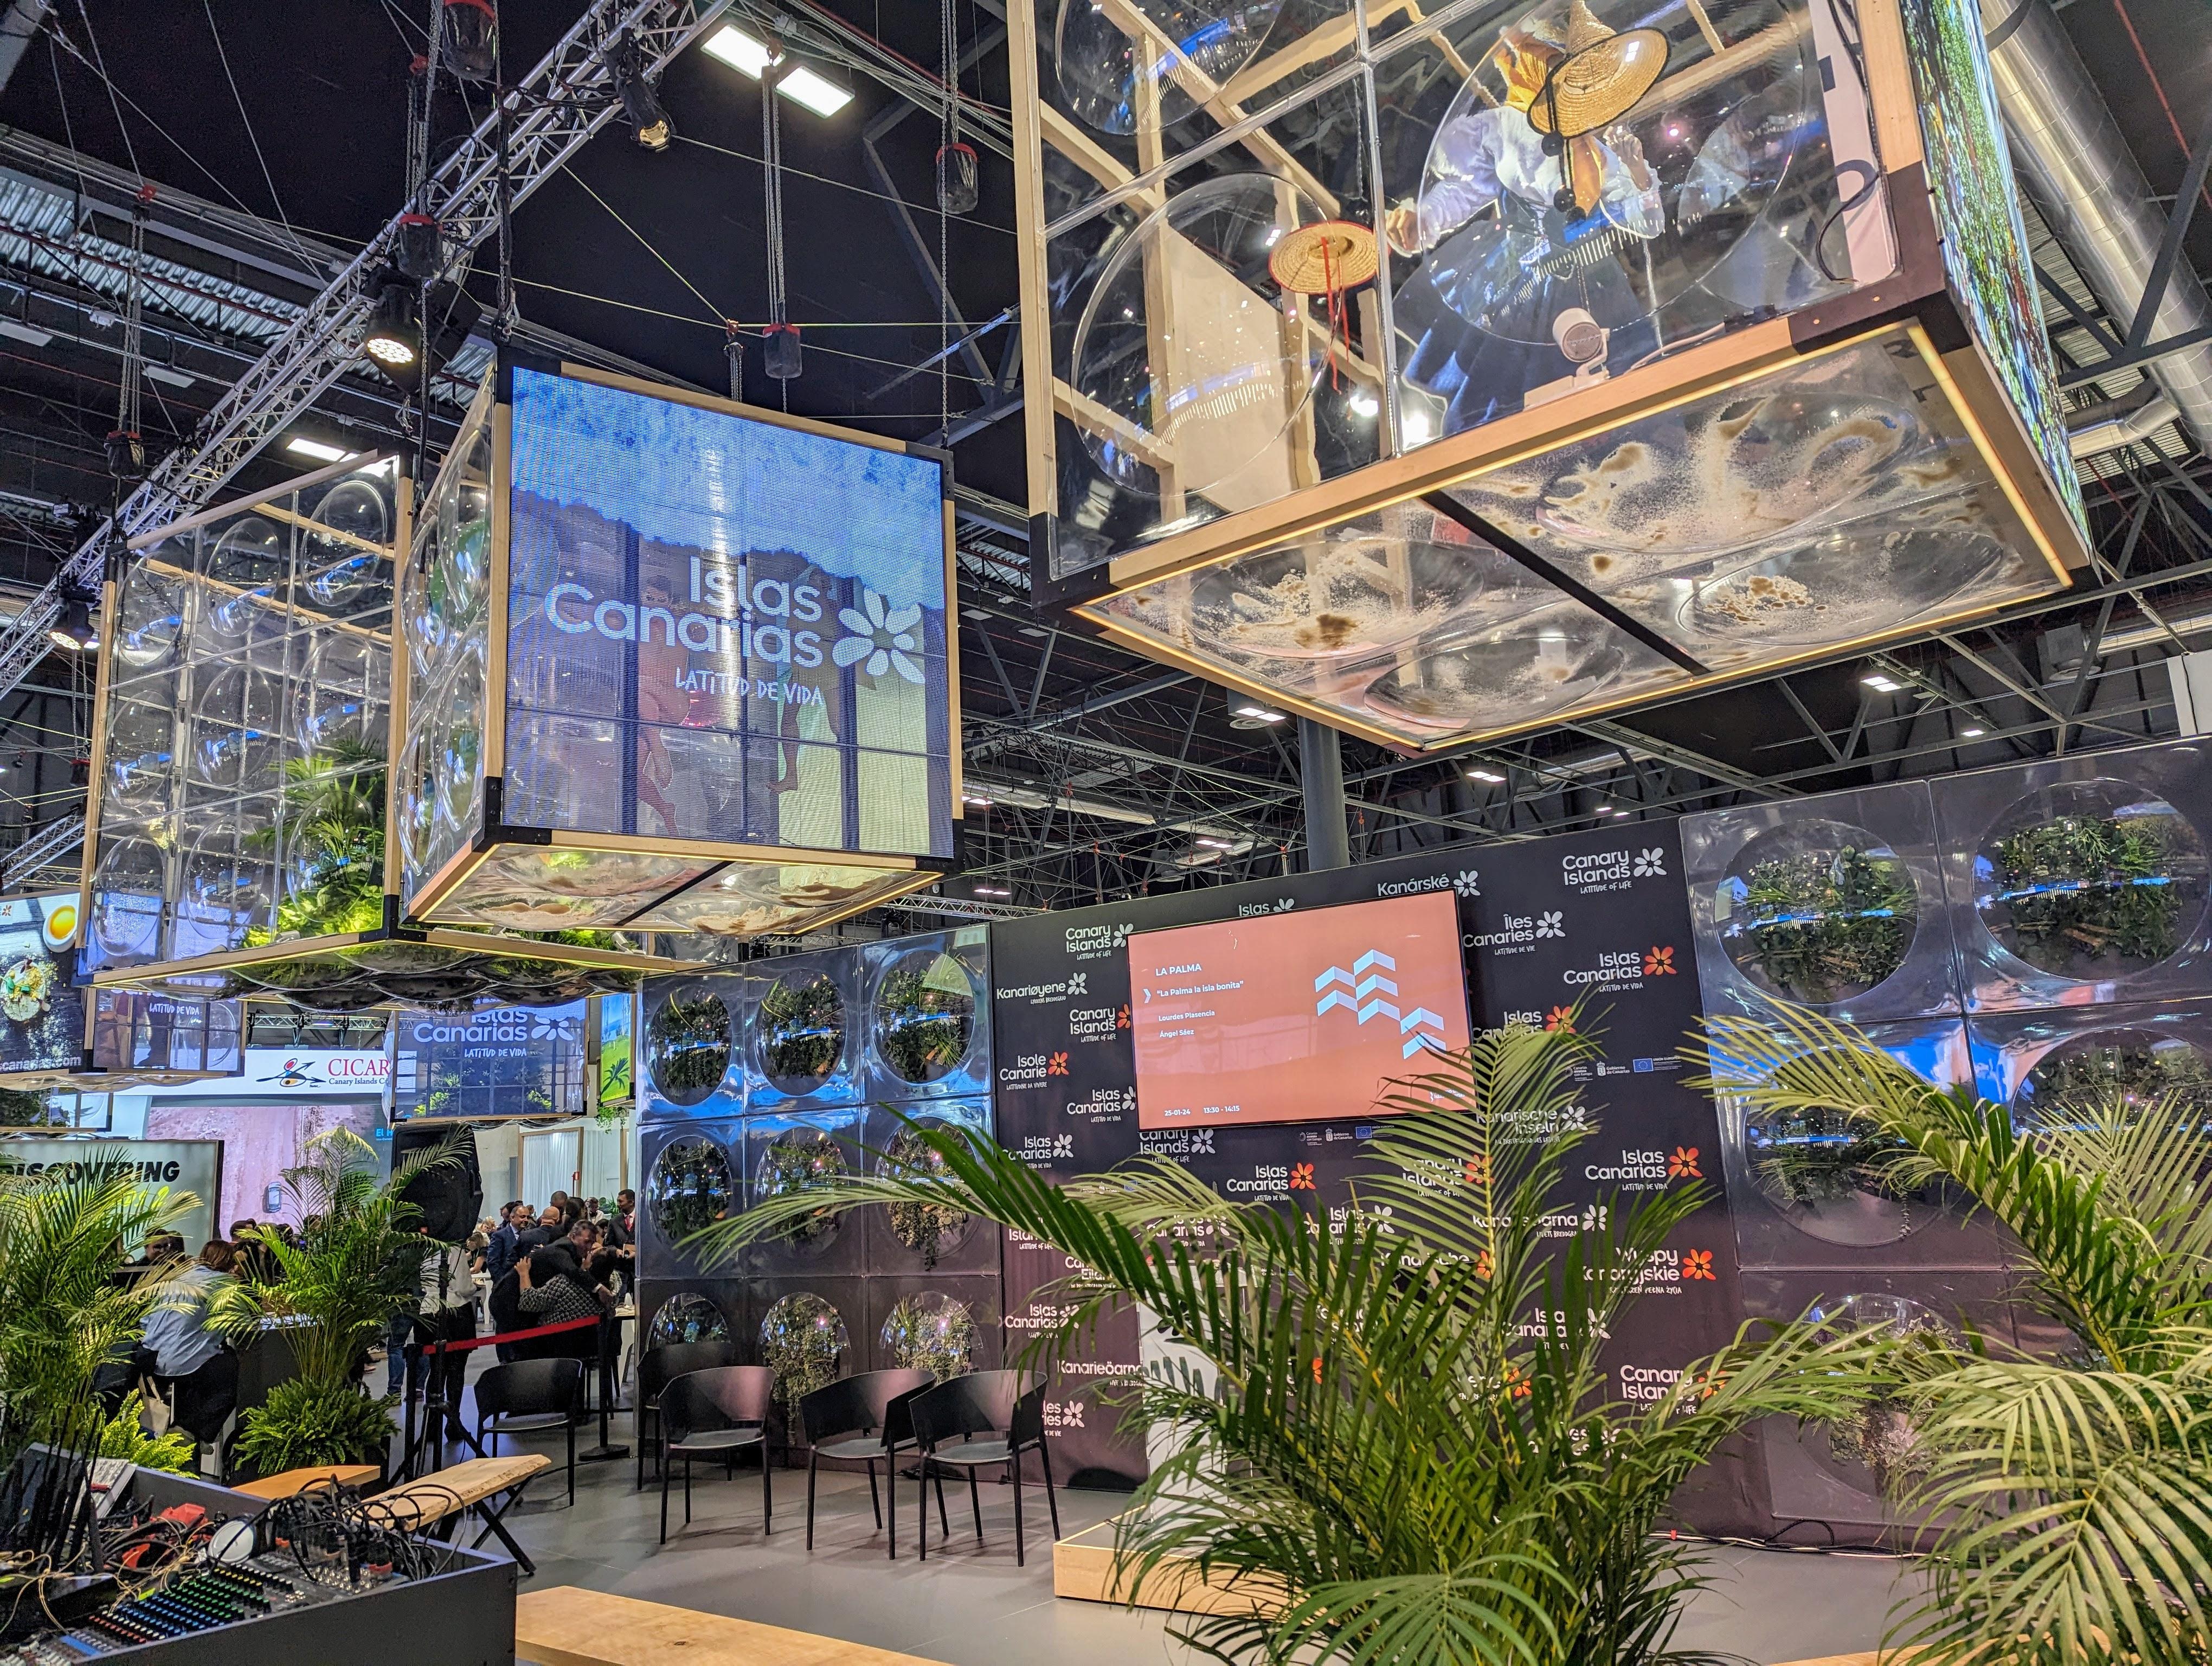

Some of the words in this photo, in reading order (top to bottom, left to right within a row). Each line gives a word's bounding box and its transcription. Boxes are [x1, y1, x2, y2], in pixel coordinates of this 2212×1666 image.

[689, 556, 823, 622] Islas
[544, 583, 824, 668] Canarias
[676, 667, 750, 696] LATITUD
[757, 679, 779, 700] DE
[782, 683, 824, 706] VIDA
[1562, 850, 1630, 870] Canary
[1564, 864, 1631, 886] Islands
[1377, 873, 1450, 896] Kanárské
[1580, 884, 1608, 894] LATITUDE
[1619, 880, 1632, 890] LIFE
[1238, 902, 1270, 917] Islas
[1503, 914, 1533, 930] Îles
[1065, 925, 1111, 940] Canary
[1463, 929, 1534, 947] Canaries
[1066, 937, 1111, 953] Islands
[1494, 947, 1518, 956] LATITUDE
[1077, 952, 1095, 960] LATITUDE
[1599, 952, 1641, 967] Islas
[1155, 967, 1168, 976] LA
[1169, 963, 1202, 975] PALMA
[1563, 965, 1642, 984] Canarias
[996, 983, 1066, 1000] Kanariøyene
[1170, 987, 1193, 996] Palma
[1203, 984, 1215, 992] isla
[1599, 983, 1621, 992] LATITUD
[1630, 982, 1644, 990] VIDA
[149, 1003, 175, 1014] LATITUD
[177, 1005, 185, 1015] DE
[185, 1005, 200, 1016] VIDA
[1069, 1007, 1115, 1022] Canary
[1158, 1014, 1184, 1022] Lourdes
[1185, 1010, 1215, 1018] Plasencia
[413, 1023, 528, 1043] Canarias
[1070, 1019, 1116, 1035] Islands
[1159, 1030, 1178, 1038] Ángel
[1081, 1035, 1100, 1043] LATITUDE
[464, 1048, 496, 1058] LATITUD
[498, 1048, 509, 1057] DE
[510, 1047, 527, 1057] VIDA
[328, 1059, 390, 1076] CICAR
[1017, 1054, 1046, 1067] Isole
[999, 1066, 1047, 1081] Canarie
[329, 1078, 353, 1086] Canary
[1092, 1089, 1120, 1101] Islas
[1066, 1099, 1121, 1115] Canarias
[376, 1128, 384, 1137] El
[1139, 1130, 1189, 1142] Canary
[1025, 1136, 1052, 1149] Islas
[1140, 1140, 1190, 1155] Islands
[1180, 1155, 1190, 1163] LIFE
[1622, 1149, 1665, 1164] Islas
[1255, 1165, 1289, 1178] Islas
[1585, 1163, 1667, 1180] Canarias
[1226, 1177, 1289, 1192] Canarias
[1030, 1304, 1058, 1317] Islas
[1005, 1314, 1058, 1329] Canarias
